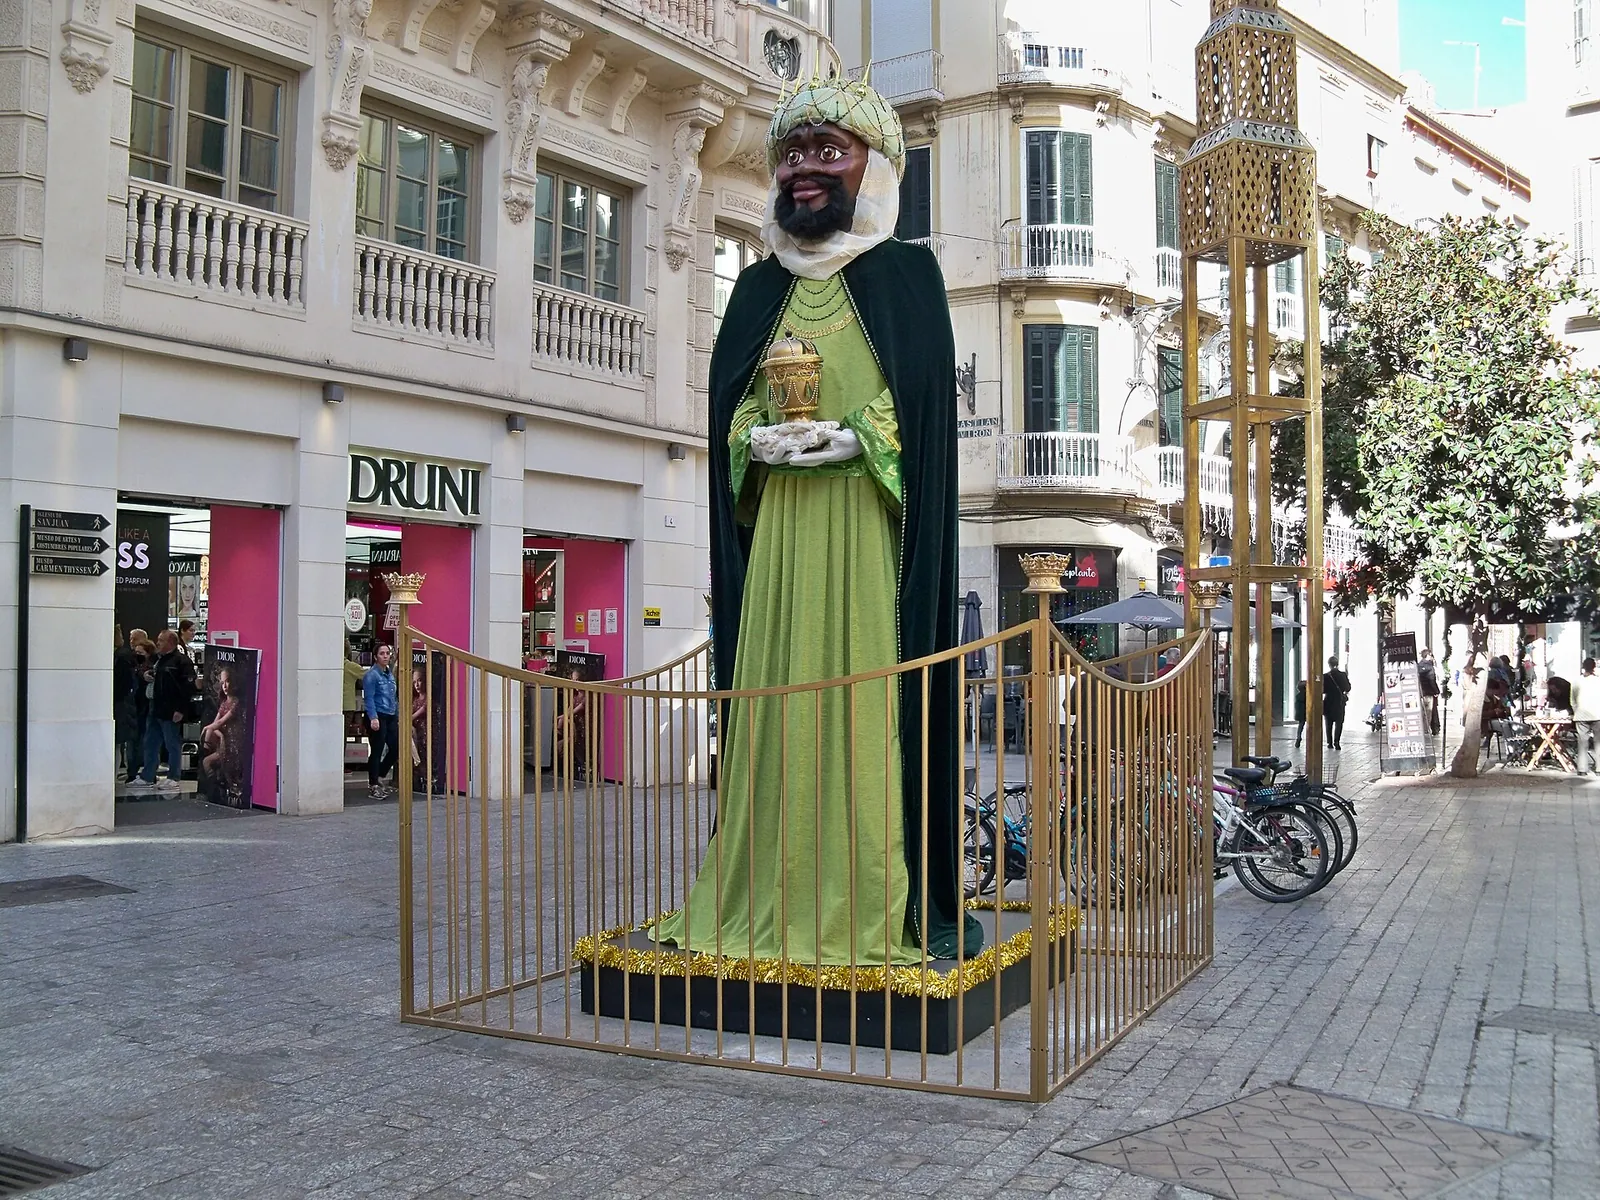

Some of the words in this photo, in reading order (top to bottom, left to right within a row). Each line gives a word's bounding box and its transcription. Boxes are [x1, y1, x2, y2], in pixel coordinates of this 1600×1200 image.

[348, 453, 481, 516] DRUNI
[37, 517, 50, 526] SAN
[51, 518, 69, 528] JUAN
[118, 528, 140, 540] LIKE
[142, 529, 150, 540] A
[36, 564, 62, 573] CARMEN
[63, 565, 92, 574] THYSSEN
[125, 576, 150, 585] PARFUM
[217, 650, 236, 663] DIOR
[569, 655, 586, 665] DIOR
